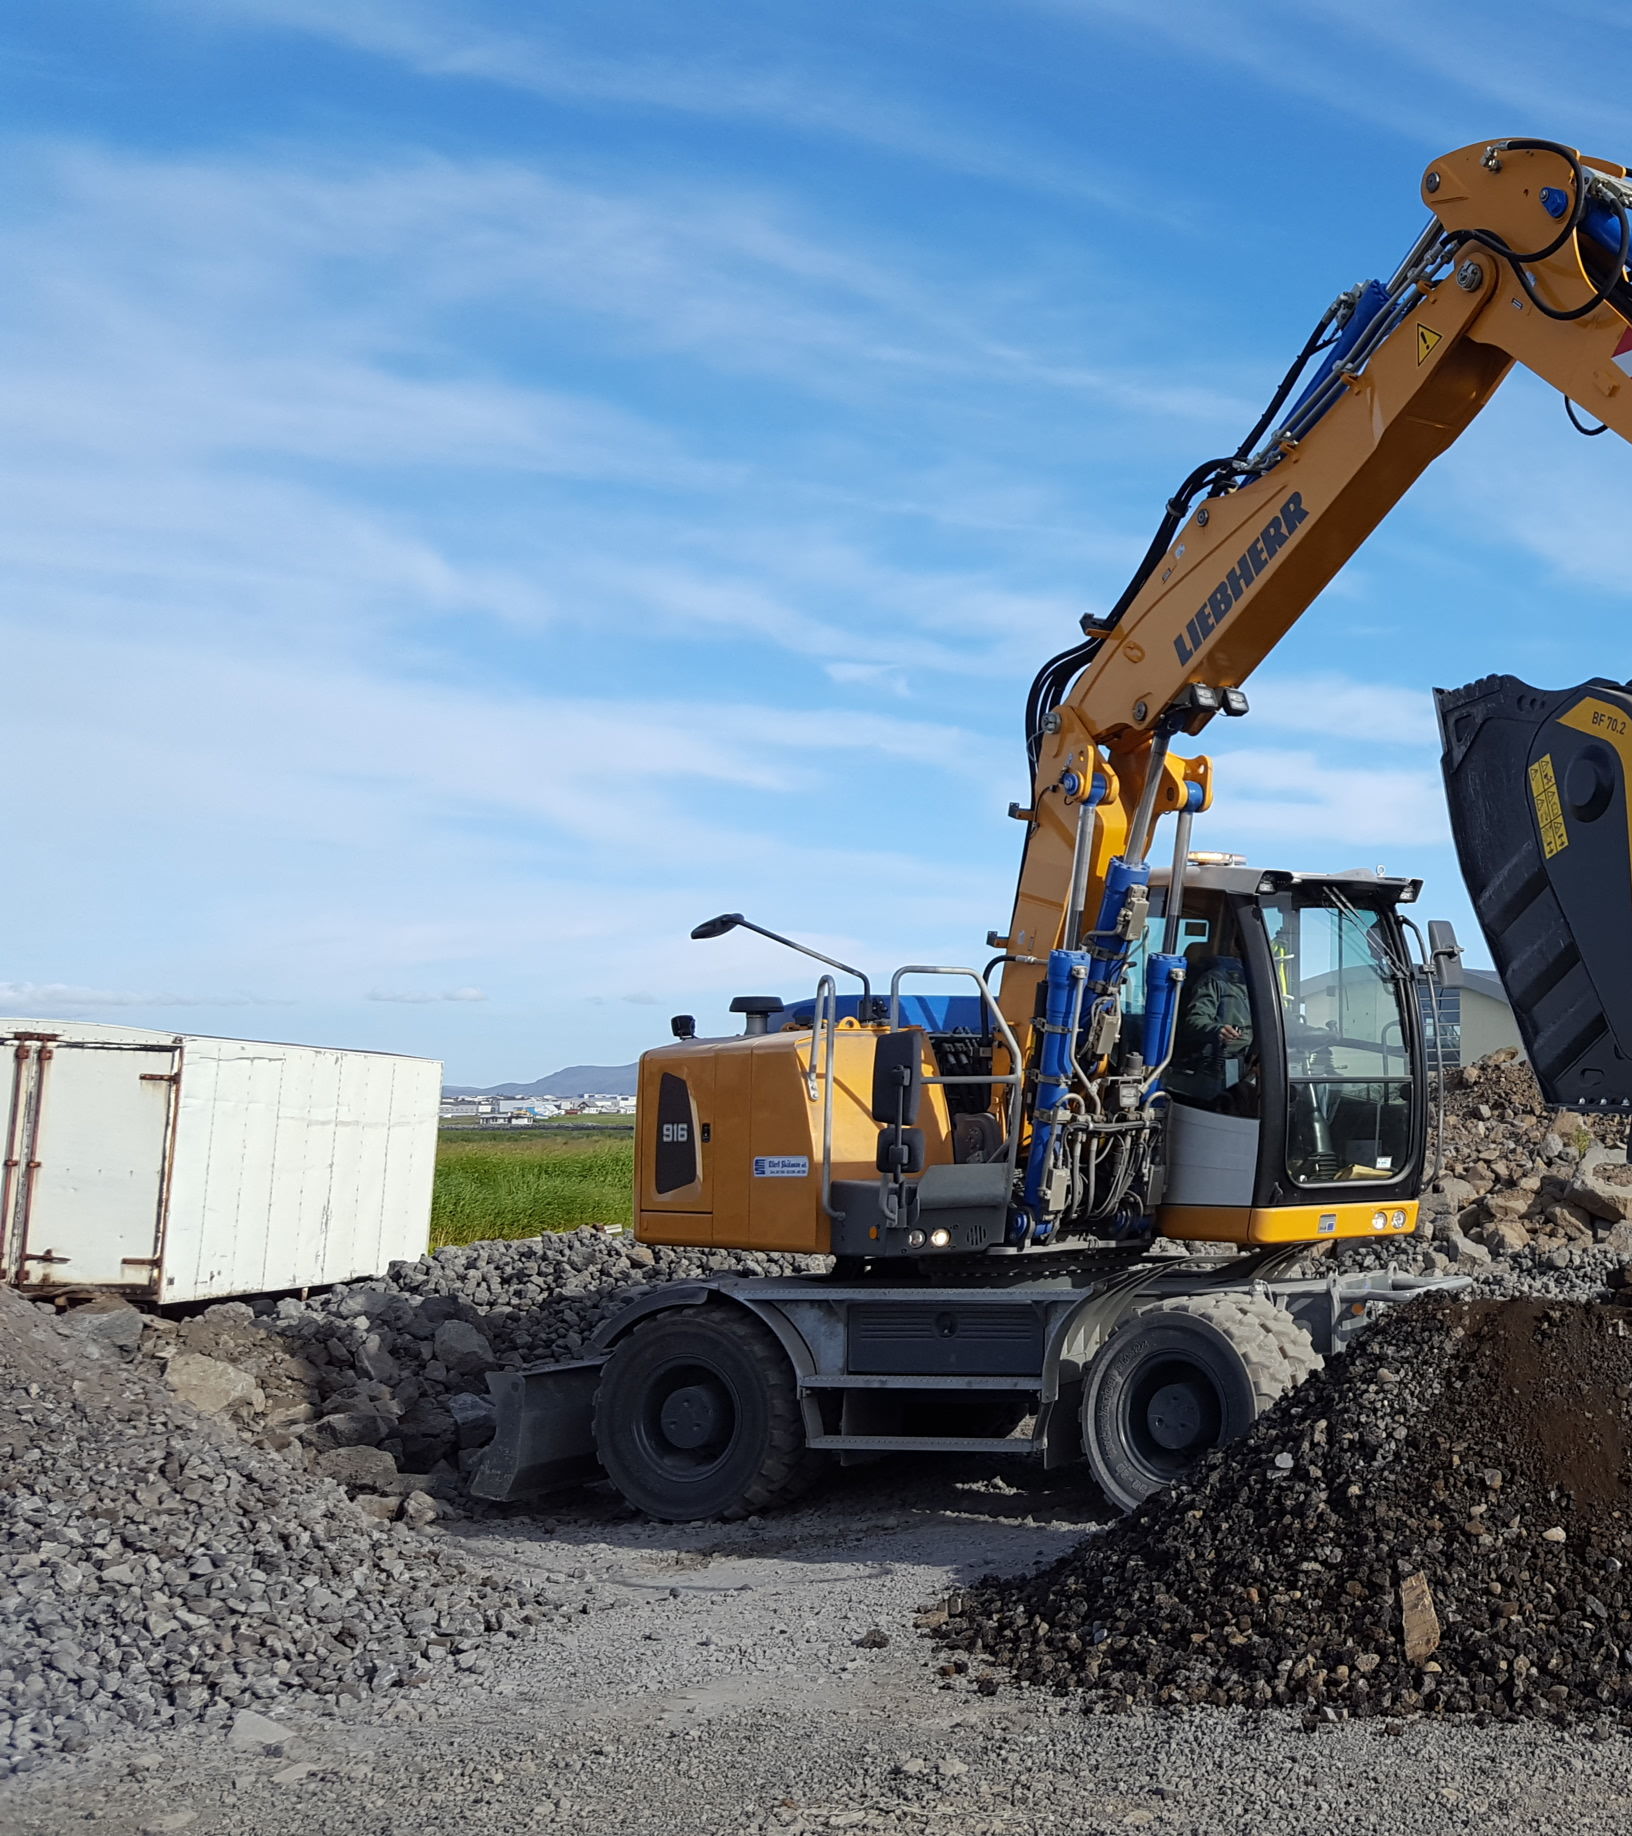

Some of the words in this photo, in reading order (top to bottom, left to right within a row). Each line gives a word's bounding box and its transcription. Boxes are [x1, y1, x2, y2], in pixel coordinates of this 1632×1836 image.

[1173, 491, 1310, 667] LIEBHERR
[1592, 711, 1606, 726] BF
[1606, 716, 1627, 735] 70.2
[663, 1123, 688, 1142] 916
